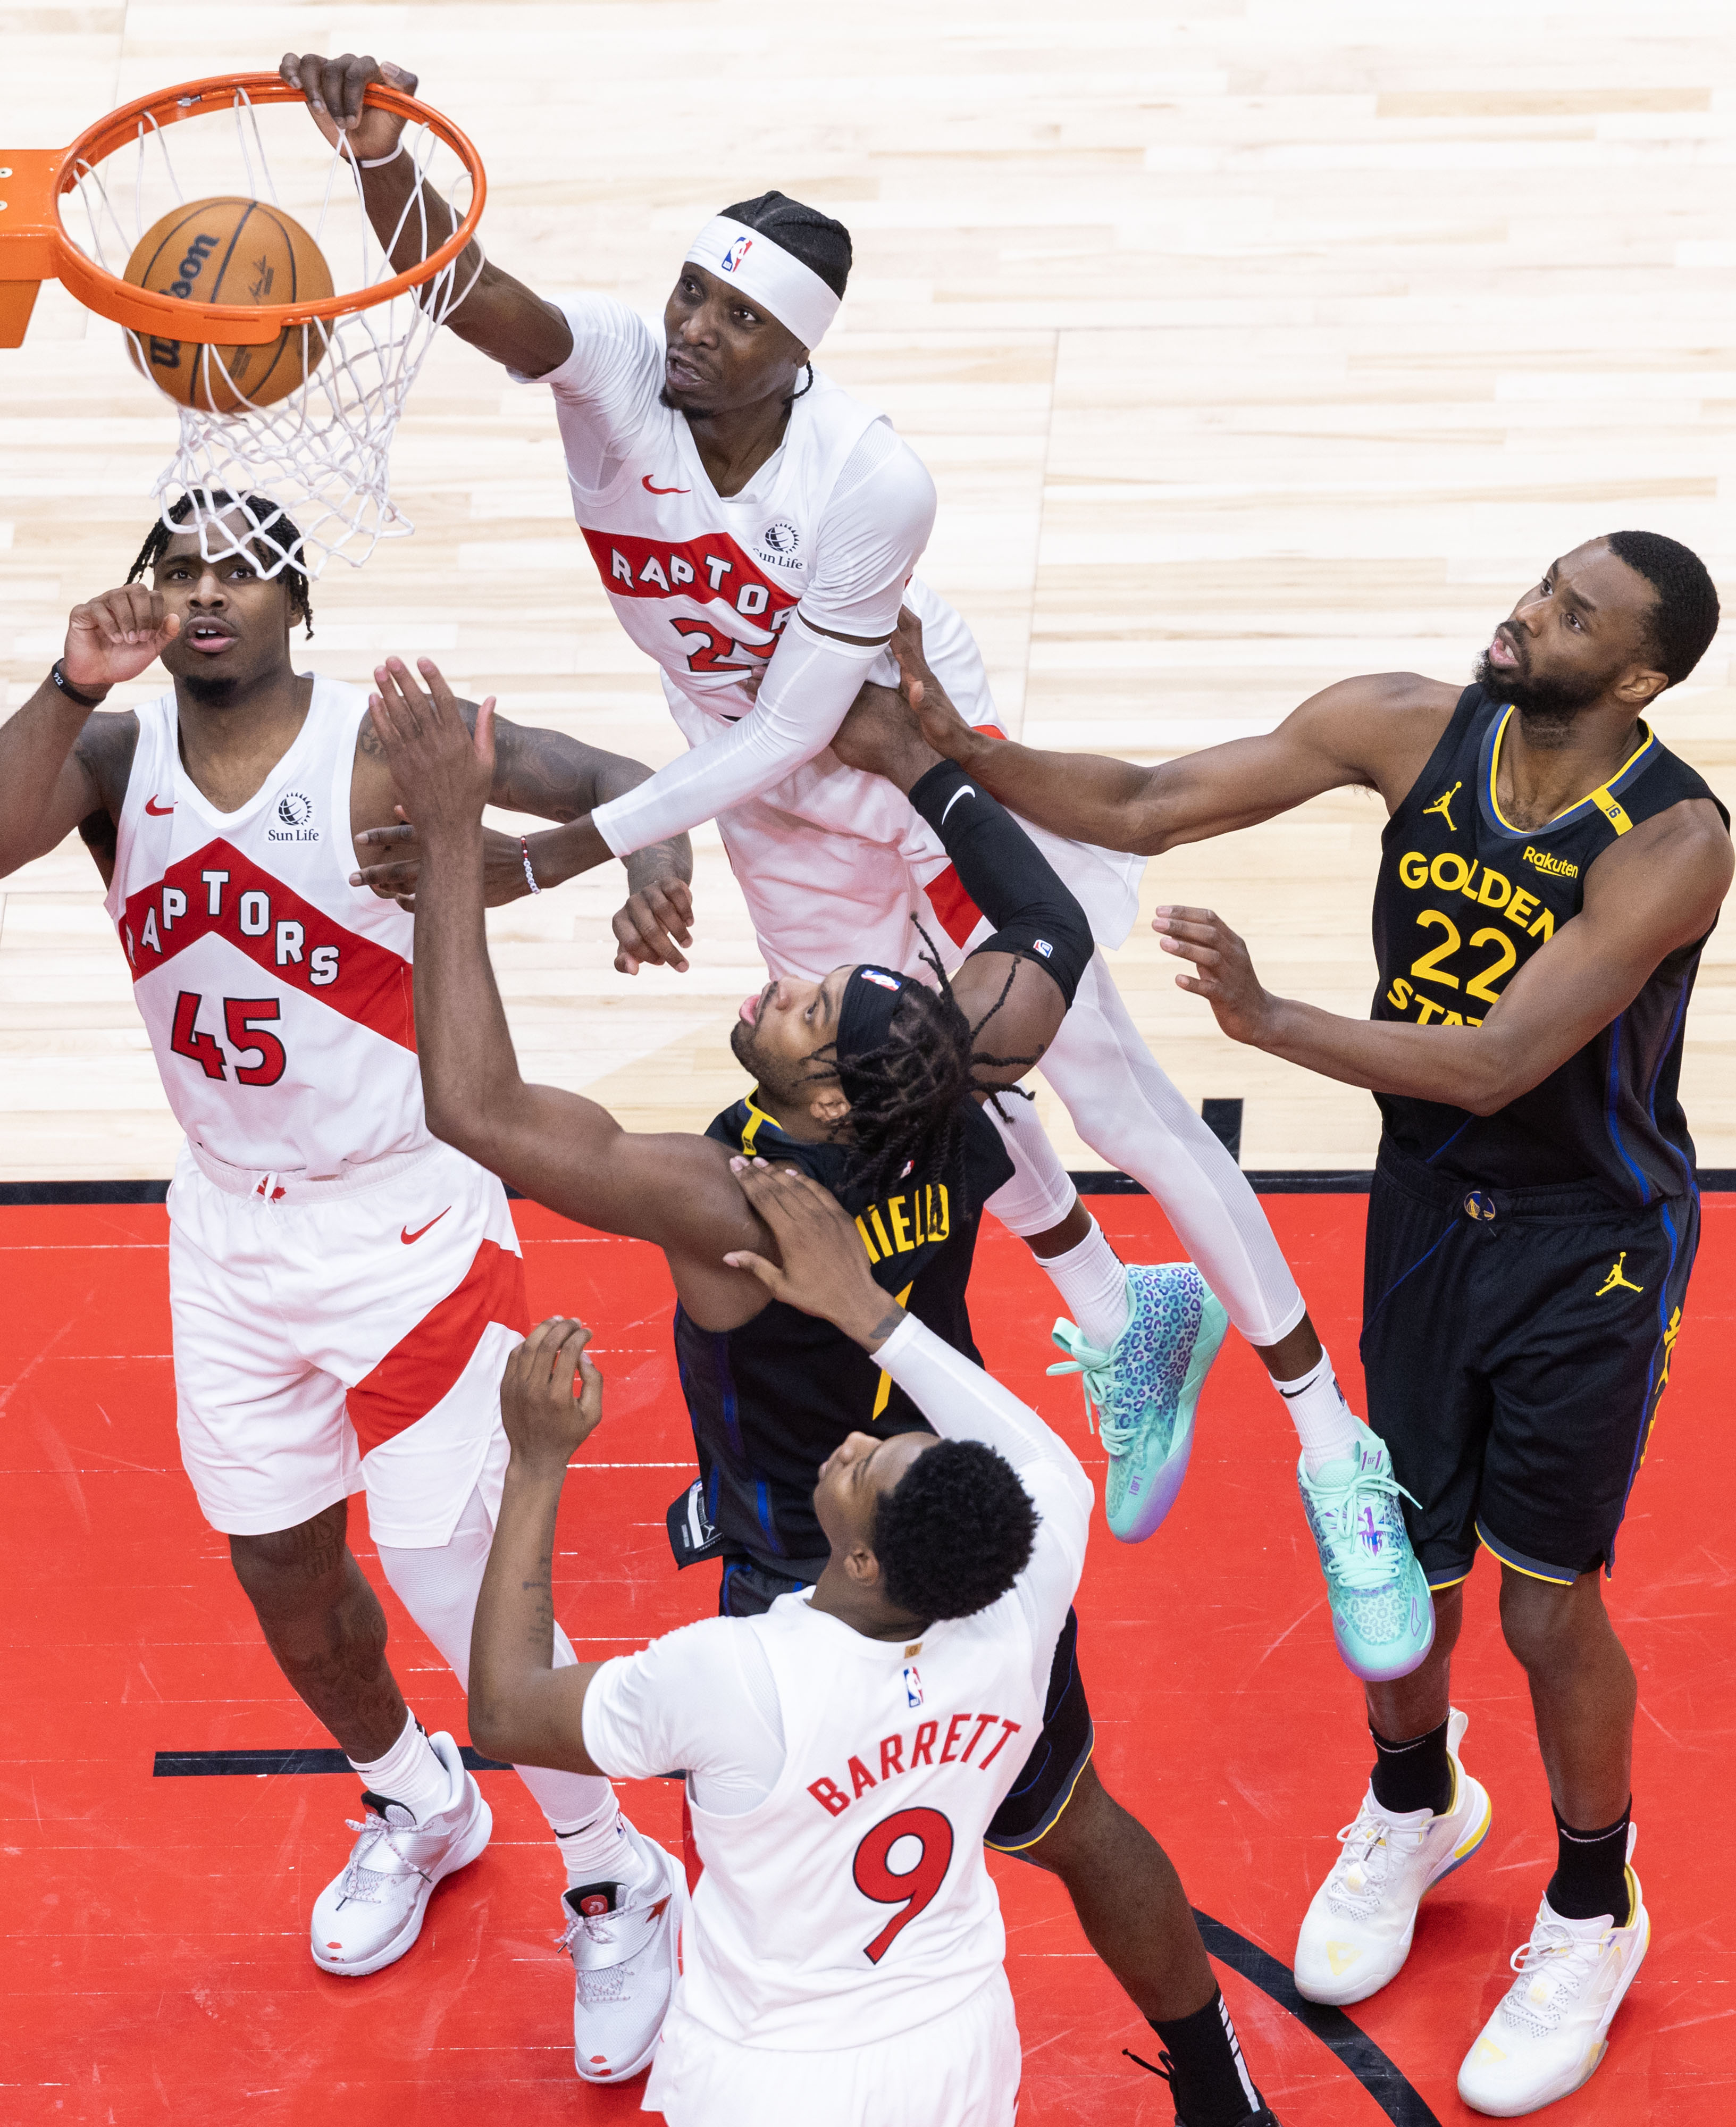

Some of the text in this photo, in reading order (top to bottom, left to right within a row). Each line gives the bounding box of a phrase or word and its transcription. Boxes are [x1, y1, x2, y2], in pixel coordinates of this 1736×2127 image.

[611, 547, 795, 632] RAPTOR
[778, 555, 803, 570] Life
[669, 617, 779, 672] 2
[268, 828, 319, 841] Sun Life
[1605, 803, 1621, 818] 16
[1399, 852, 1555, 944] GOLDEN
[1522, 845, 1578, 879] Rakuten
[125, 869, 339, 985] RAPTORS
[1411, 909, 1516, 1004] 22
[171, 991, 287, 1086] 45
[855, 1184, 950, 1265] IELD
[807, 1713, 1021, 1817] BARRETT
[852, 1806, 954, 1965] 9
